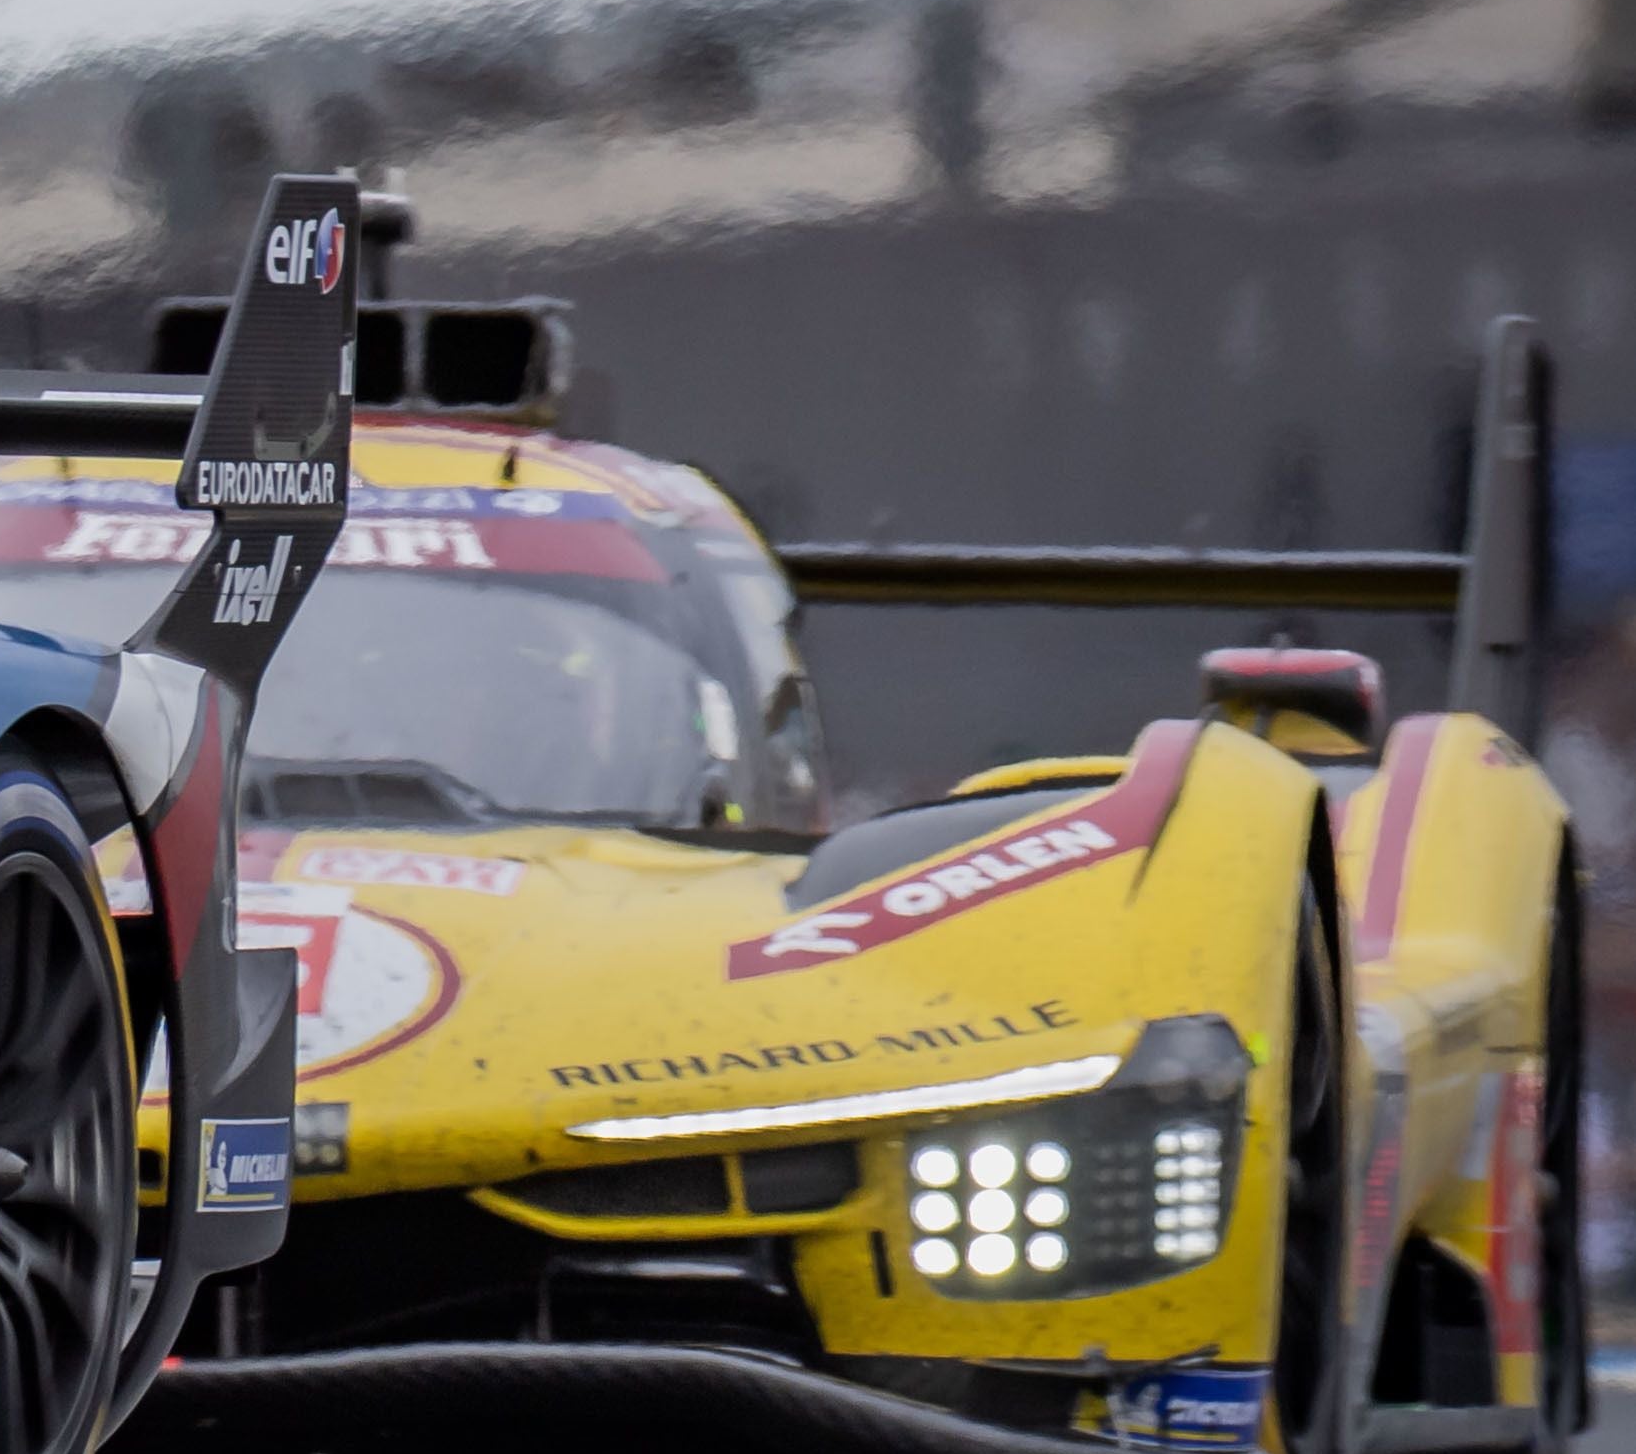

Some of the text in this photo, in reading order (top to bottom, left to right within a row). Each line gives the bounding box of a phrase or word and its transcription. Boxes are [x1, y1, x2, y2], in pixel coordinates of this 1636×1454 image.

[266, 218, 317, 285] elf
[197, 461, 336, 506] EURODATACAR
[213, 534, 294, 626] ixell
[883, 820, 1118, 917] ORLEN
[549, 998, 1082, 1088] RICHARD MILLE
